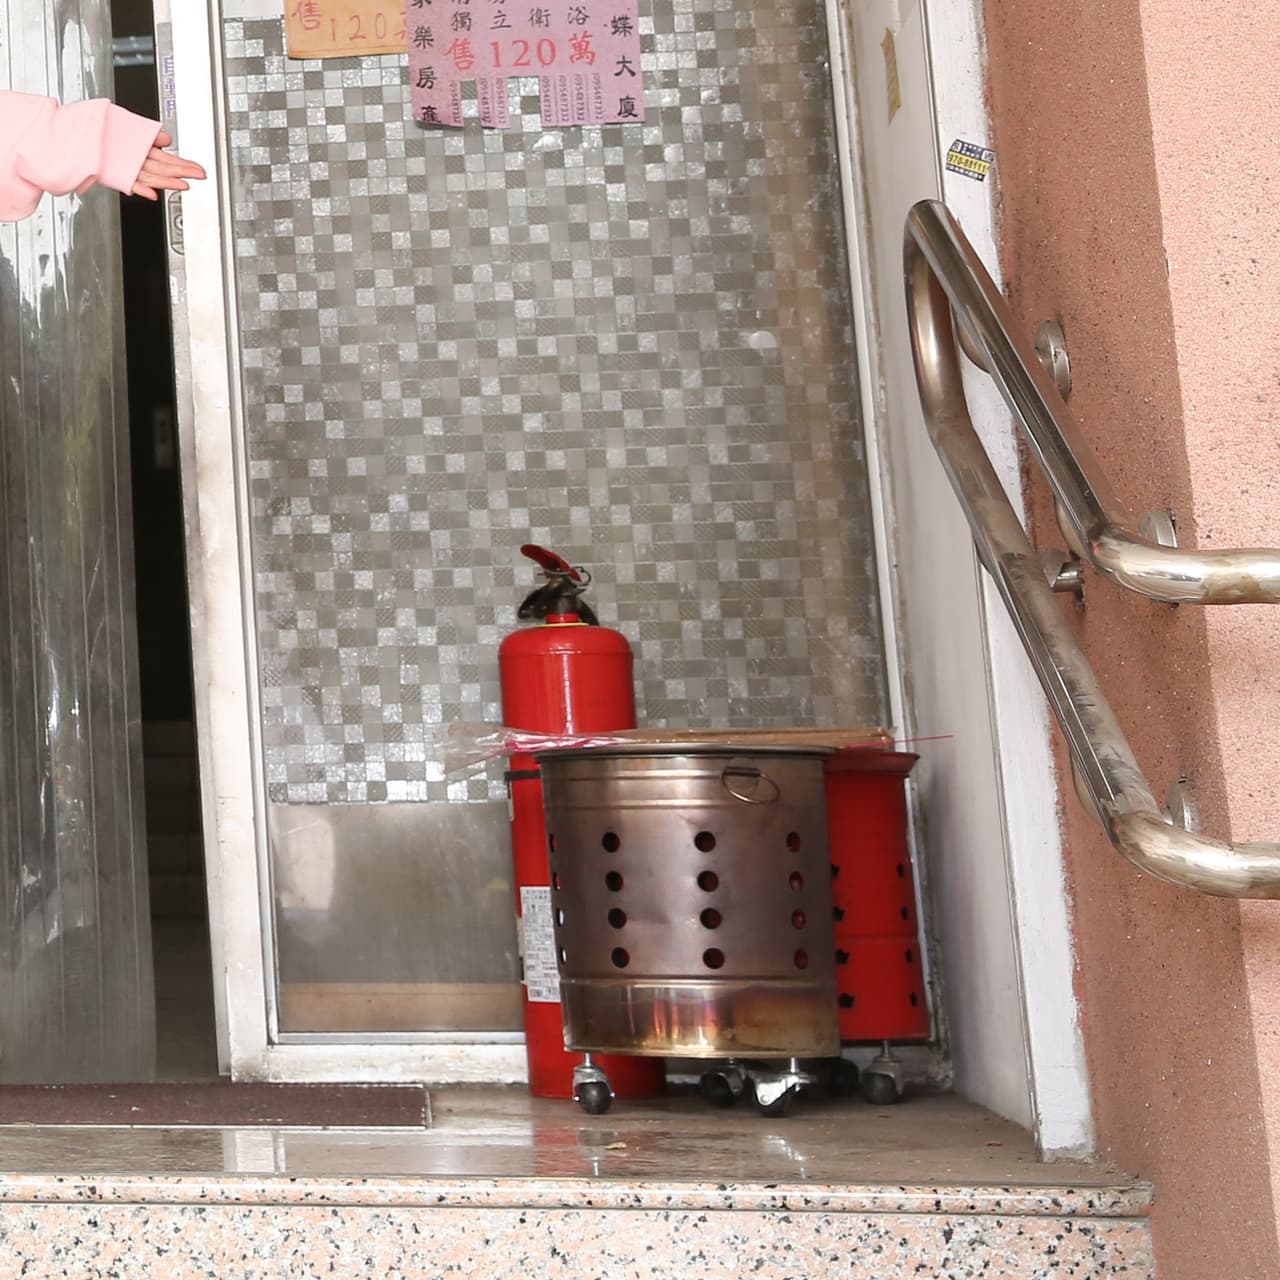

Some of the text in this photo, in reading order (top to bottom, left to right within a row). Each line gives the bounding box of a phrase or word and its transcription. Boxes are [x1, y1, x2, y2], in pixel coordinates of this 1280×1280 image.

[450, 5, 591, 32] 獨立衛浴
[443, 30, 597, 71] 售120萬
